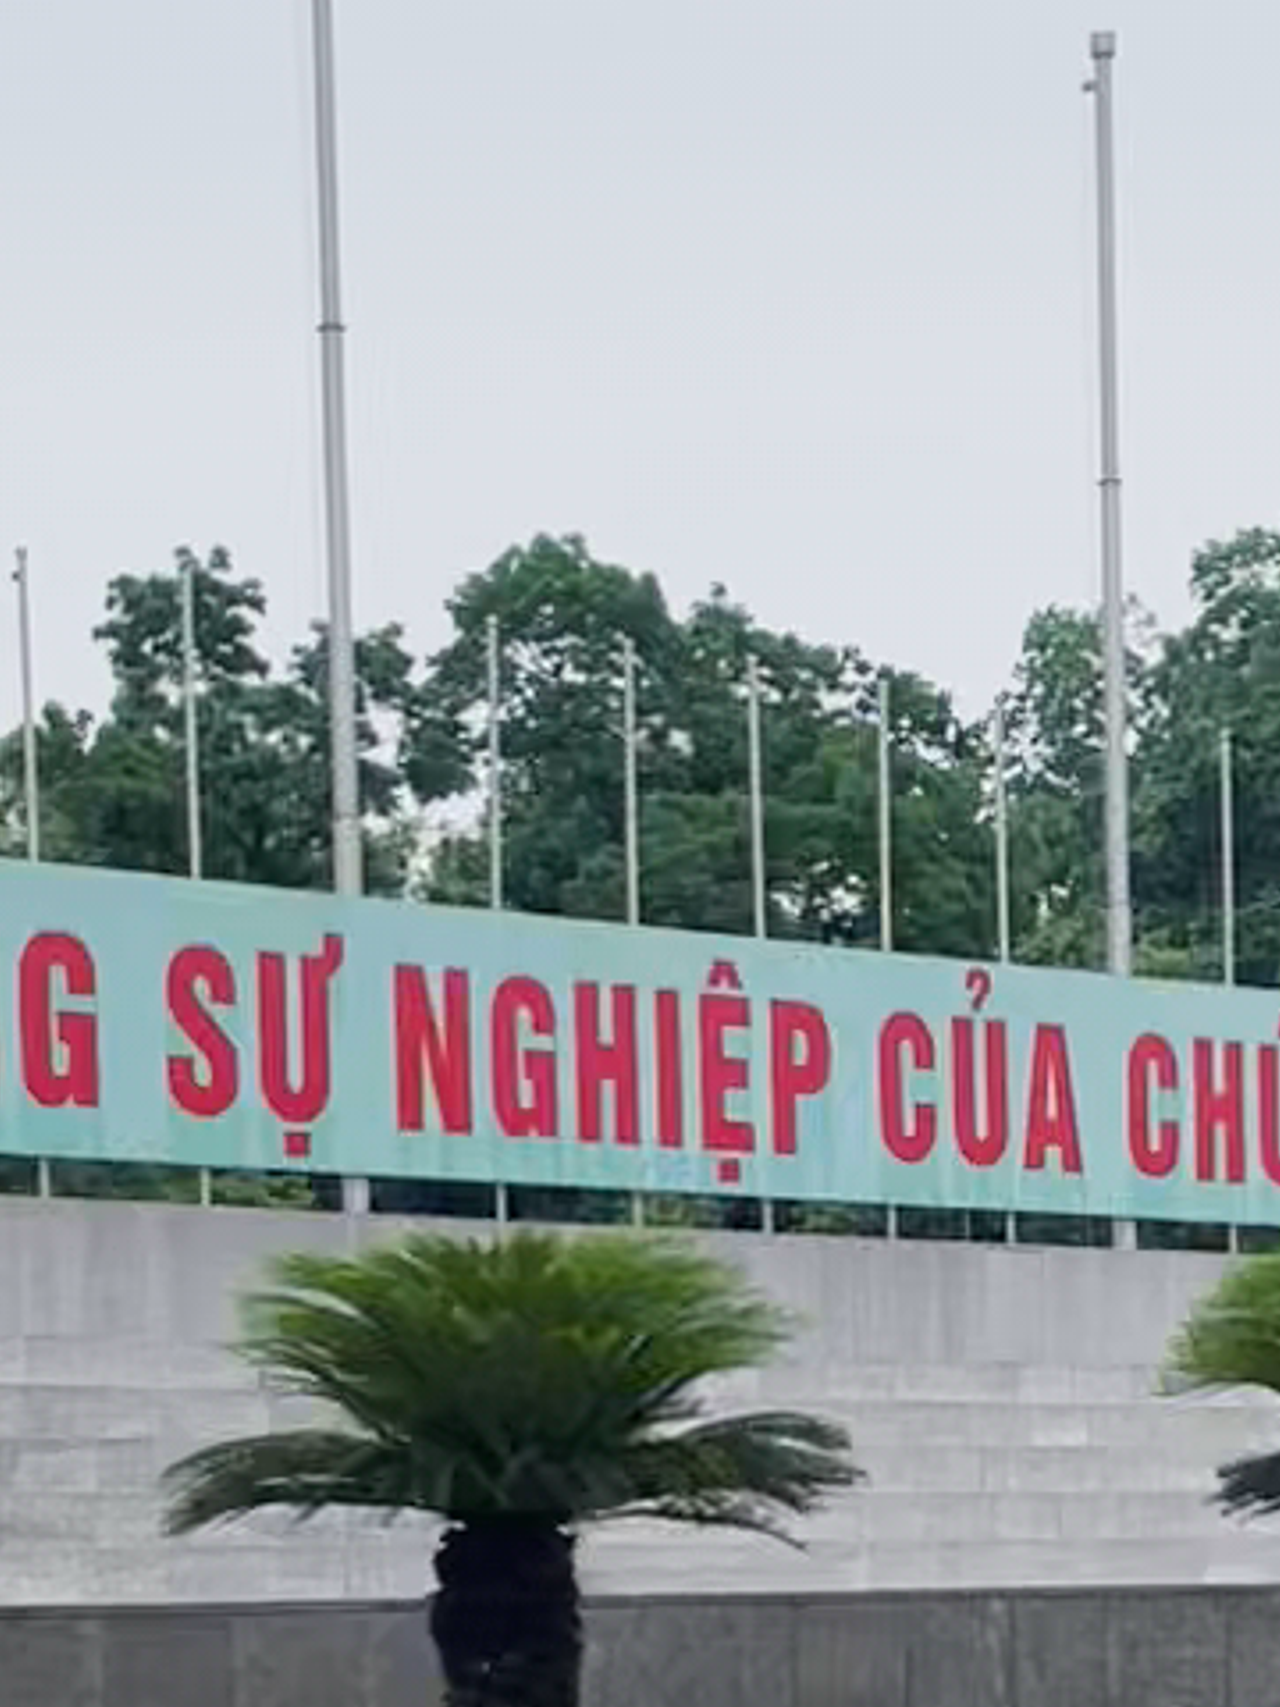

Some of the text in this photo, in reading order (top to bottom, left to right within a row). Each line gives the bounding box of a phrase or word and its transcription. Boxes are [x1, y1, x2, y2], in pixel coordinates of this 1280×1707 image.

[162, 933, 344, 1159] SỰ
[393, 959, 833, 1183] NGHIỆP
[877, 968, 1084, 1174] CỦA
